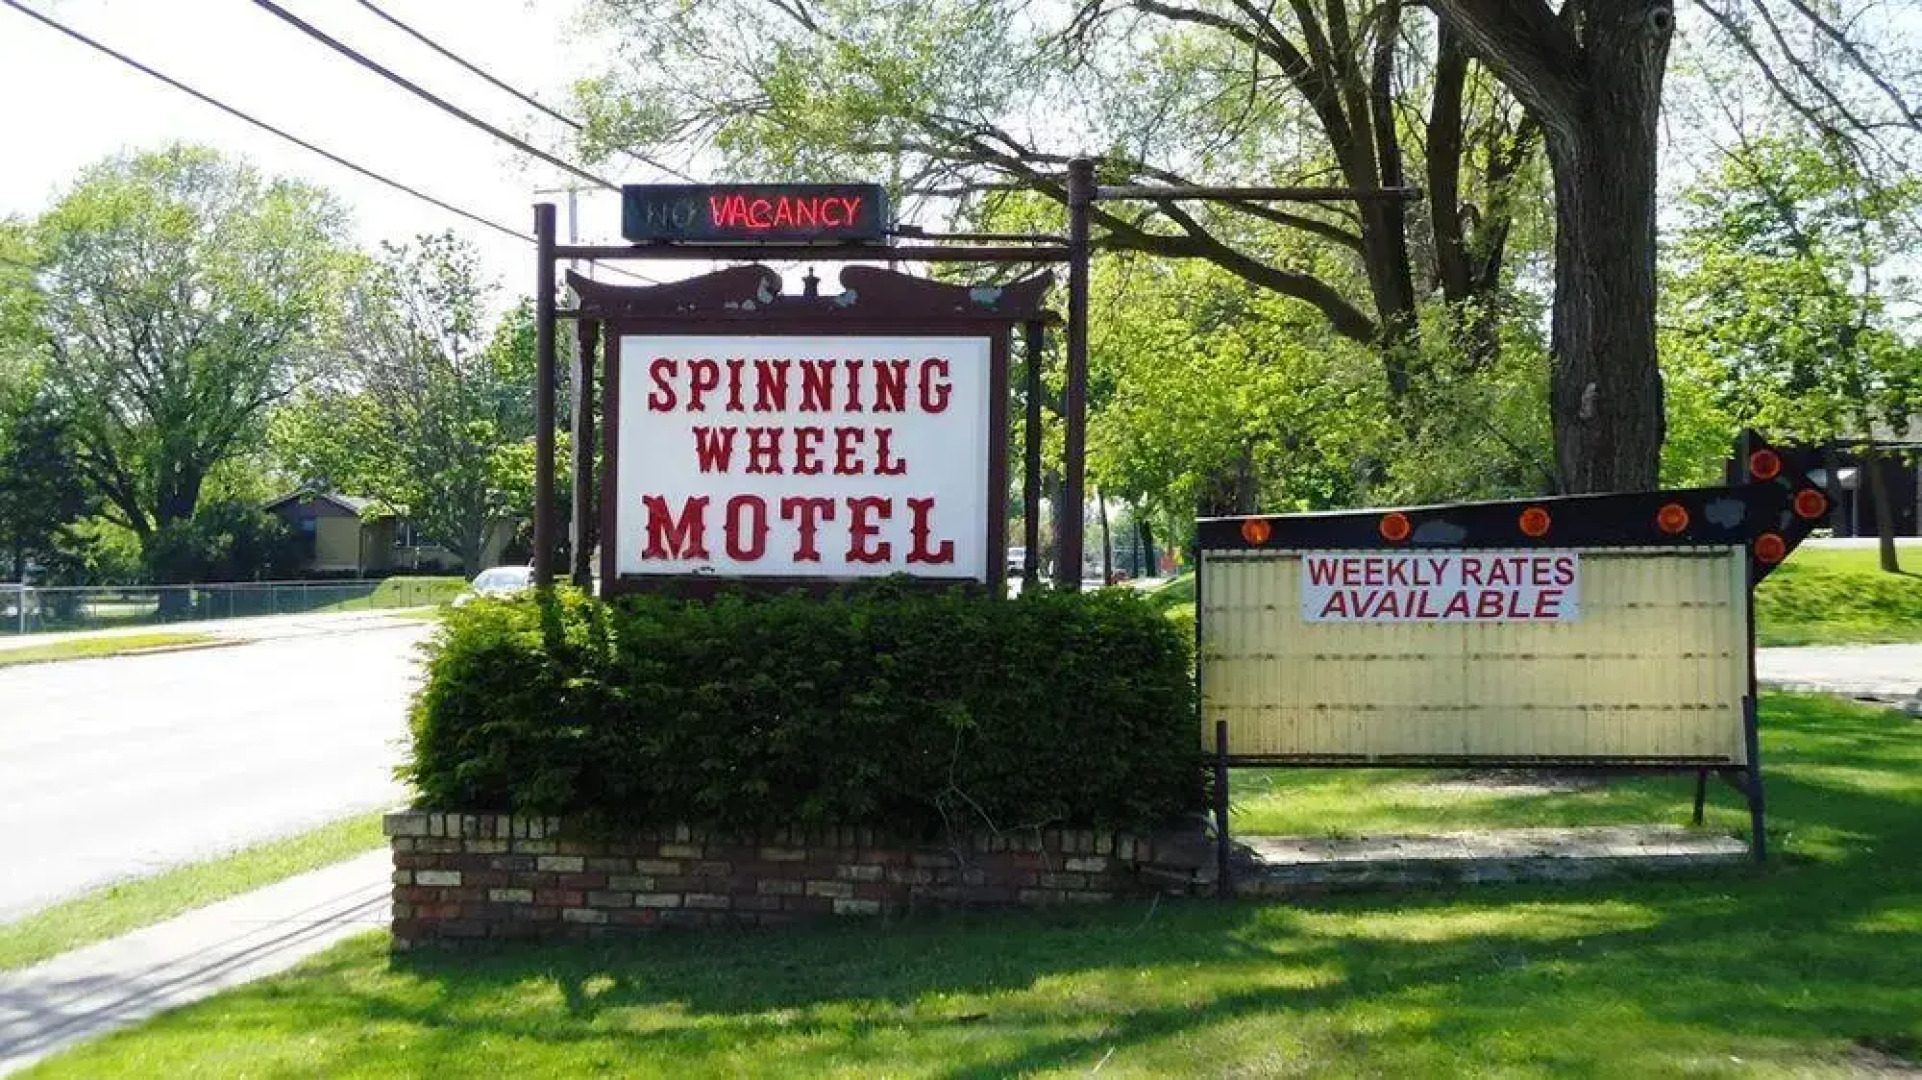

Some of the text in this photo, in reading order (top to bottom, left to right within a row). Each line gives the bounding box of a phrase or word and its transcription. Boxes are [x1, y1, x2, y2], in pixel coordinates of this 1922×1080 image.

[710, 194, 862, 228] VACANCY
[648, 357, 952, 414] SPINNING
[692, 426, 907, 475] WHEEL
[641, 494, 954, 564] MOTEL
[1308, 557, 1575, 586] WEEKLY RATES
[1320, 589, 1564, 618] AVAILABLE
